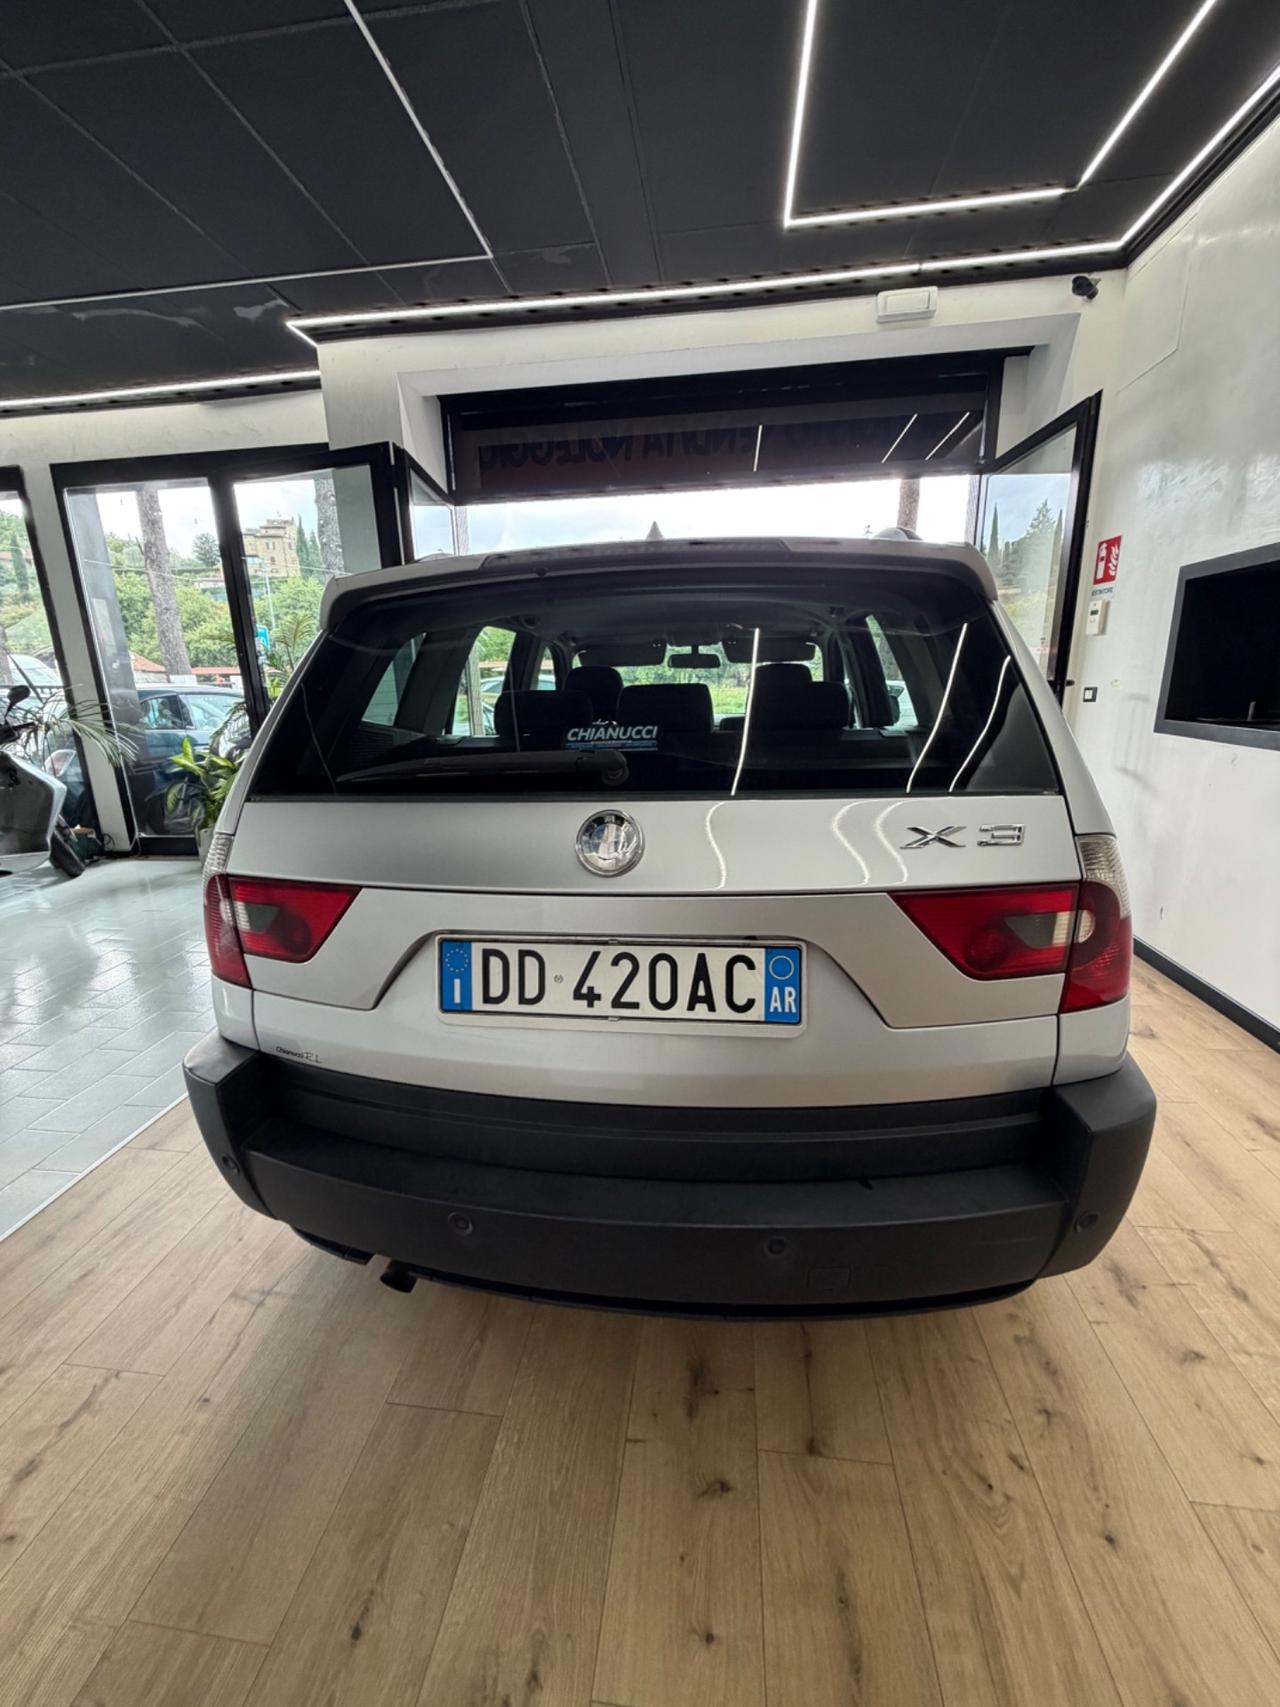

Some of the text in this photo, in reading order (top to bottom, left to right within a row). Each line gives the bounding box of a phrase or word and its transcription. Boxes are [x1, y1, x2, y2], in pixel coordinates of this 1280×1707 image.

[566, 725, 659, 741] CHIANUCCI
[899, 823, 1026, 849] X3
[481, 948, 756, 1014] DD 420AC
[769, 986, 797, 1013] AR
